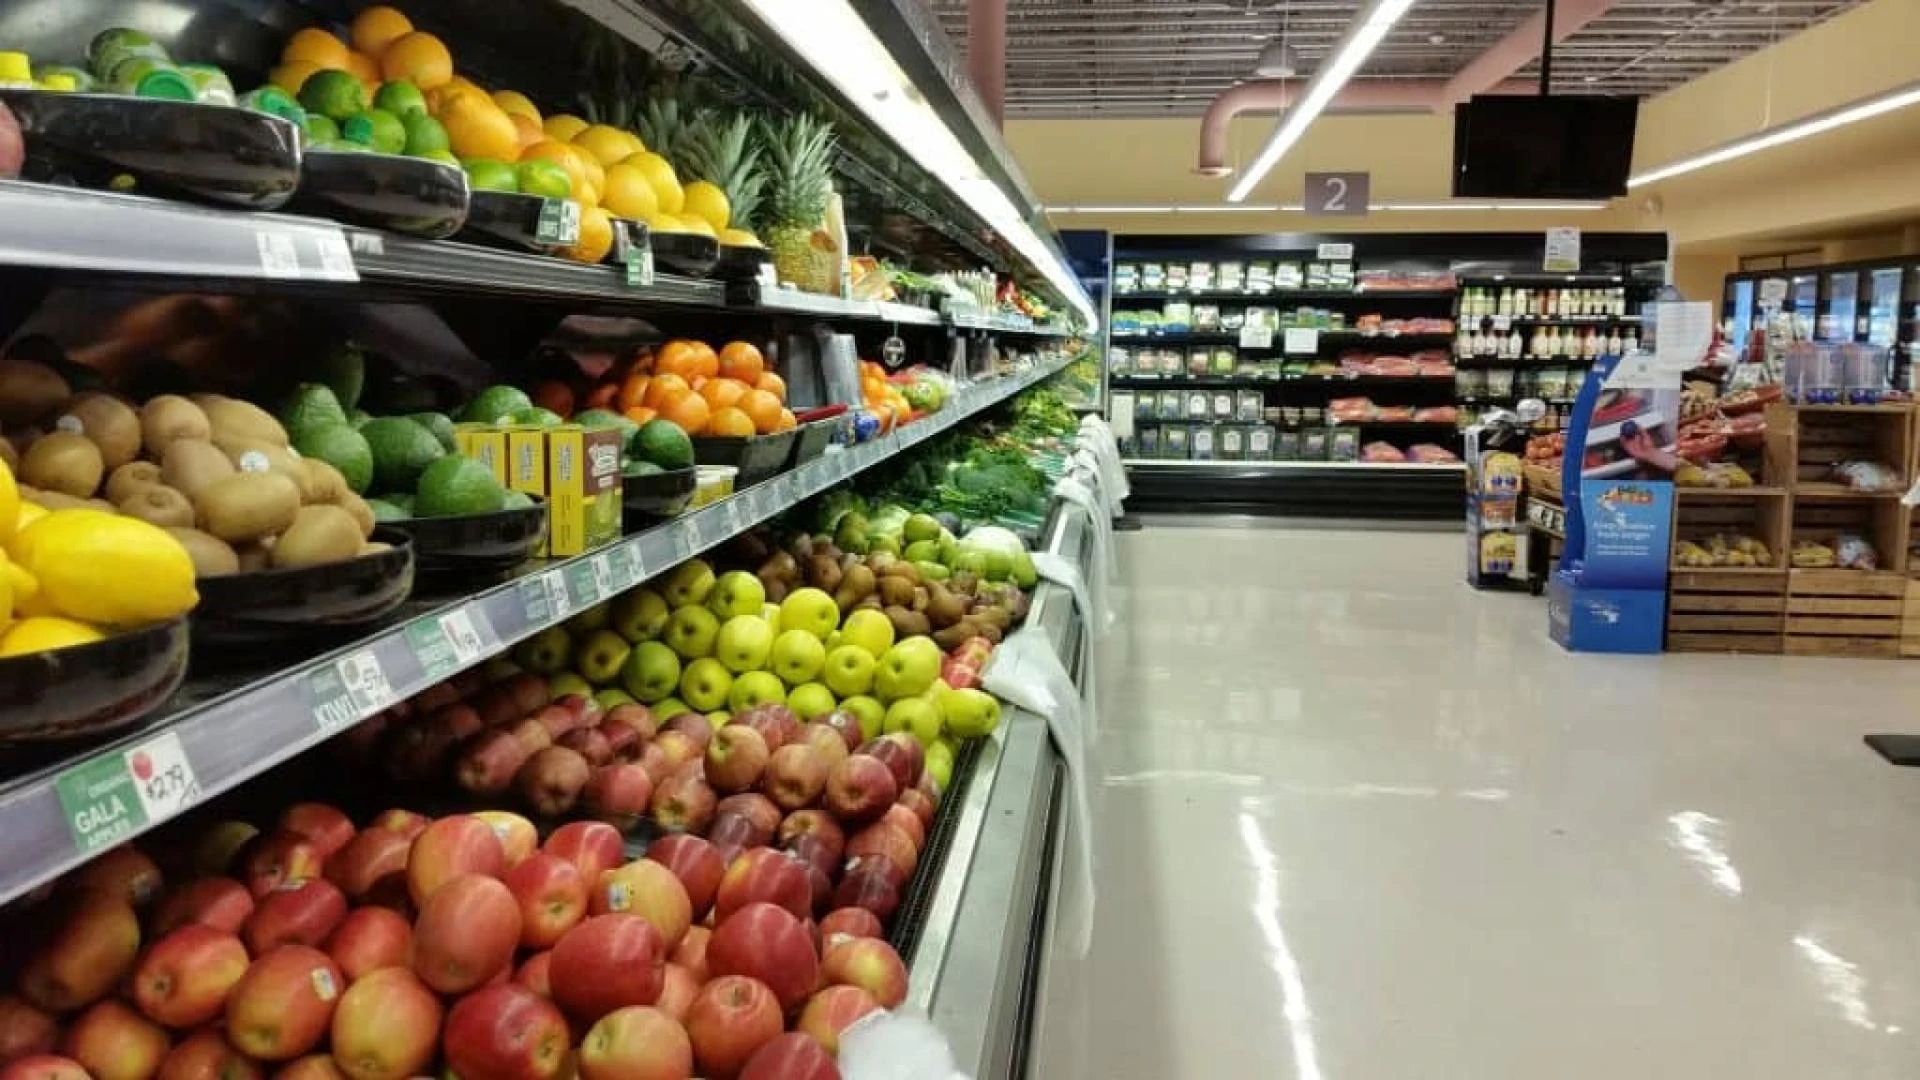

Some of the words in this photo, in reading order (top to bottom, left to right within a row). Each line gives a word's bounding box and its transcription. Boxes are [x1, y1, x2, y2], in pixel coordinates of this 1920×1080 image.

[1323, 177, 1348, 211] 2
[313, 694, 360, 728] KIWI
[75, 796, 128, 835] GALA
